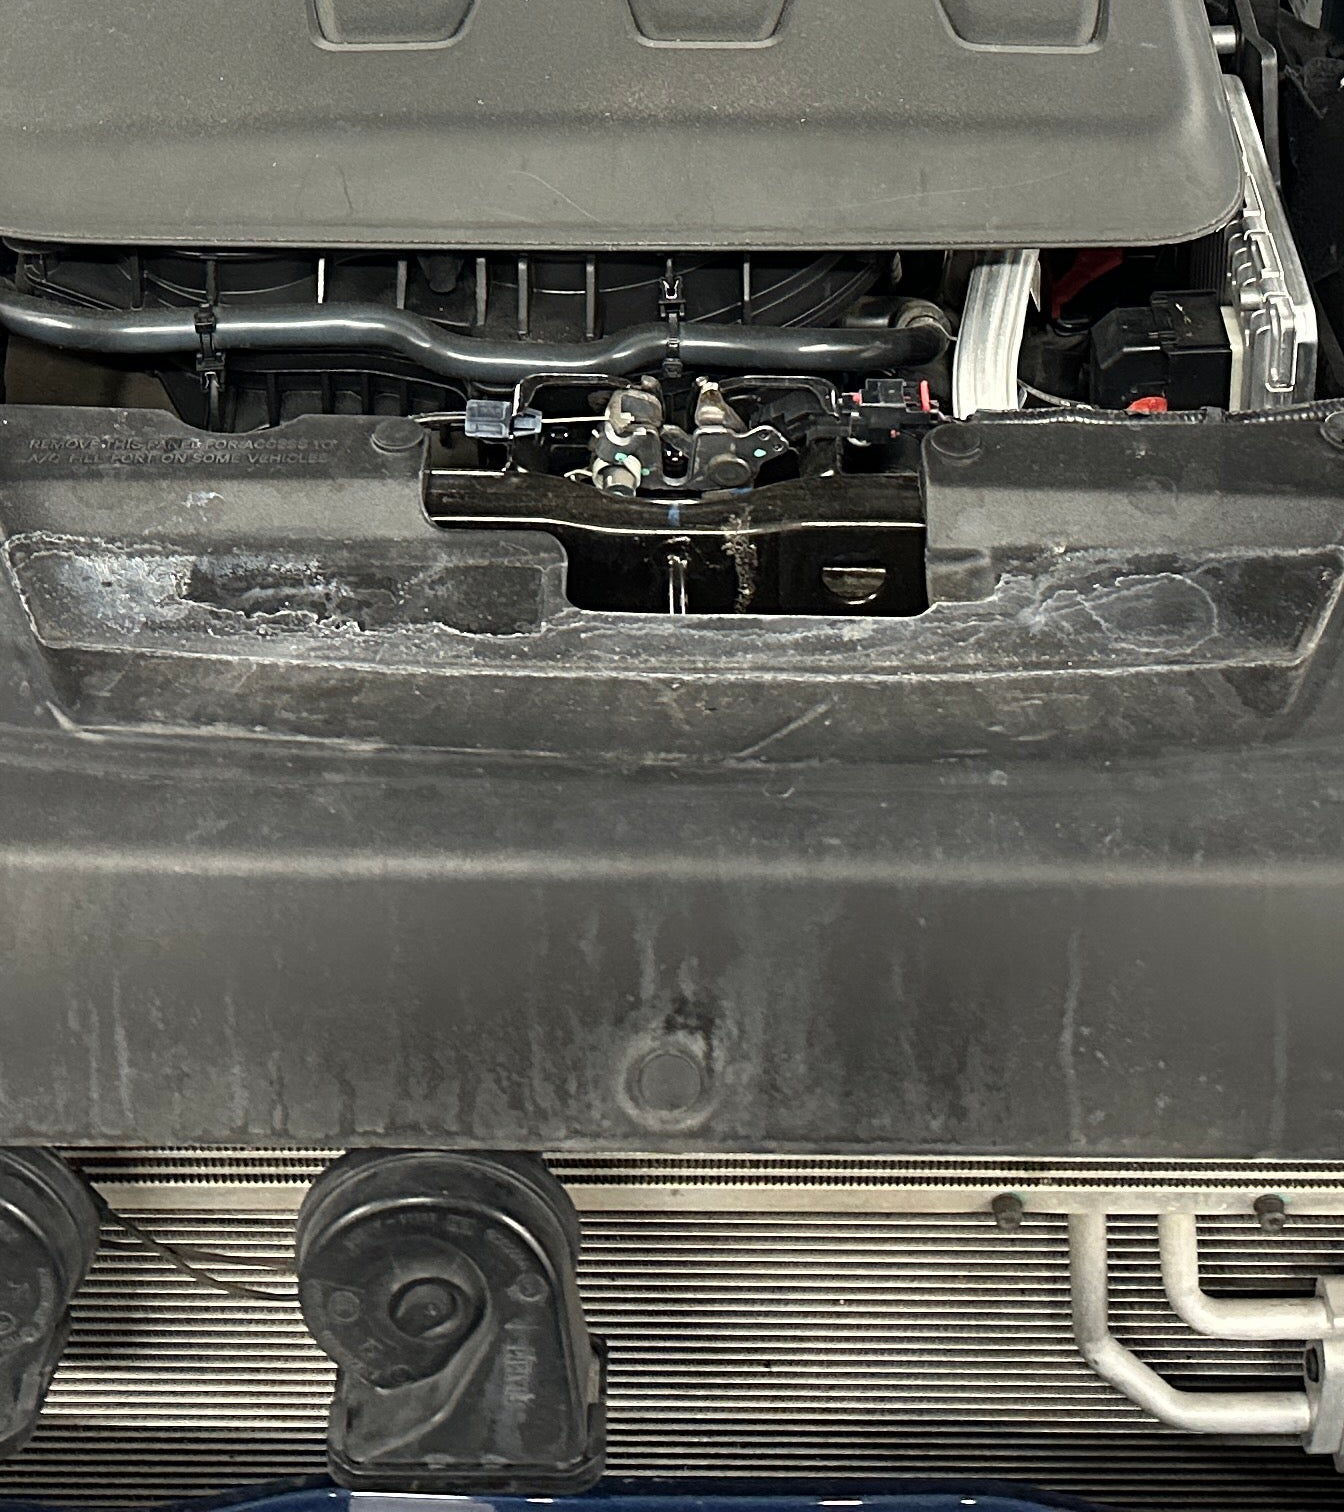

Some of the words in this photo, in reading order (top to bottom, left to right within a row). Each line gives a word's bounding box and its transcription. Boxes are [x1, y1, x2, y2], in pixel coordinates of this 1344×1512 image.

[29, 438, 101, 450] REMOVE
[105, 438, 142, 450] THIS
[205, 438, 238, 450] FOR
[240, 438, 308, 450] ACCESS
[69, 452, 104, 464] FILL
[111, 452, 157, 464] PORT
[161, 452, 186, 464] ON
[191, 452, 242, 464] SOME
[247, 452, 332, 464] VEHICLES
